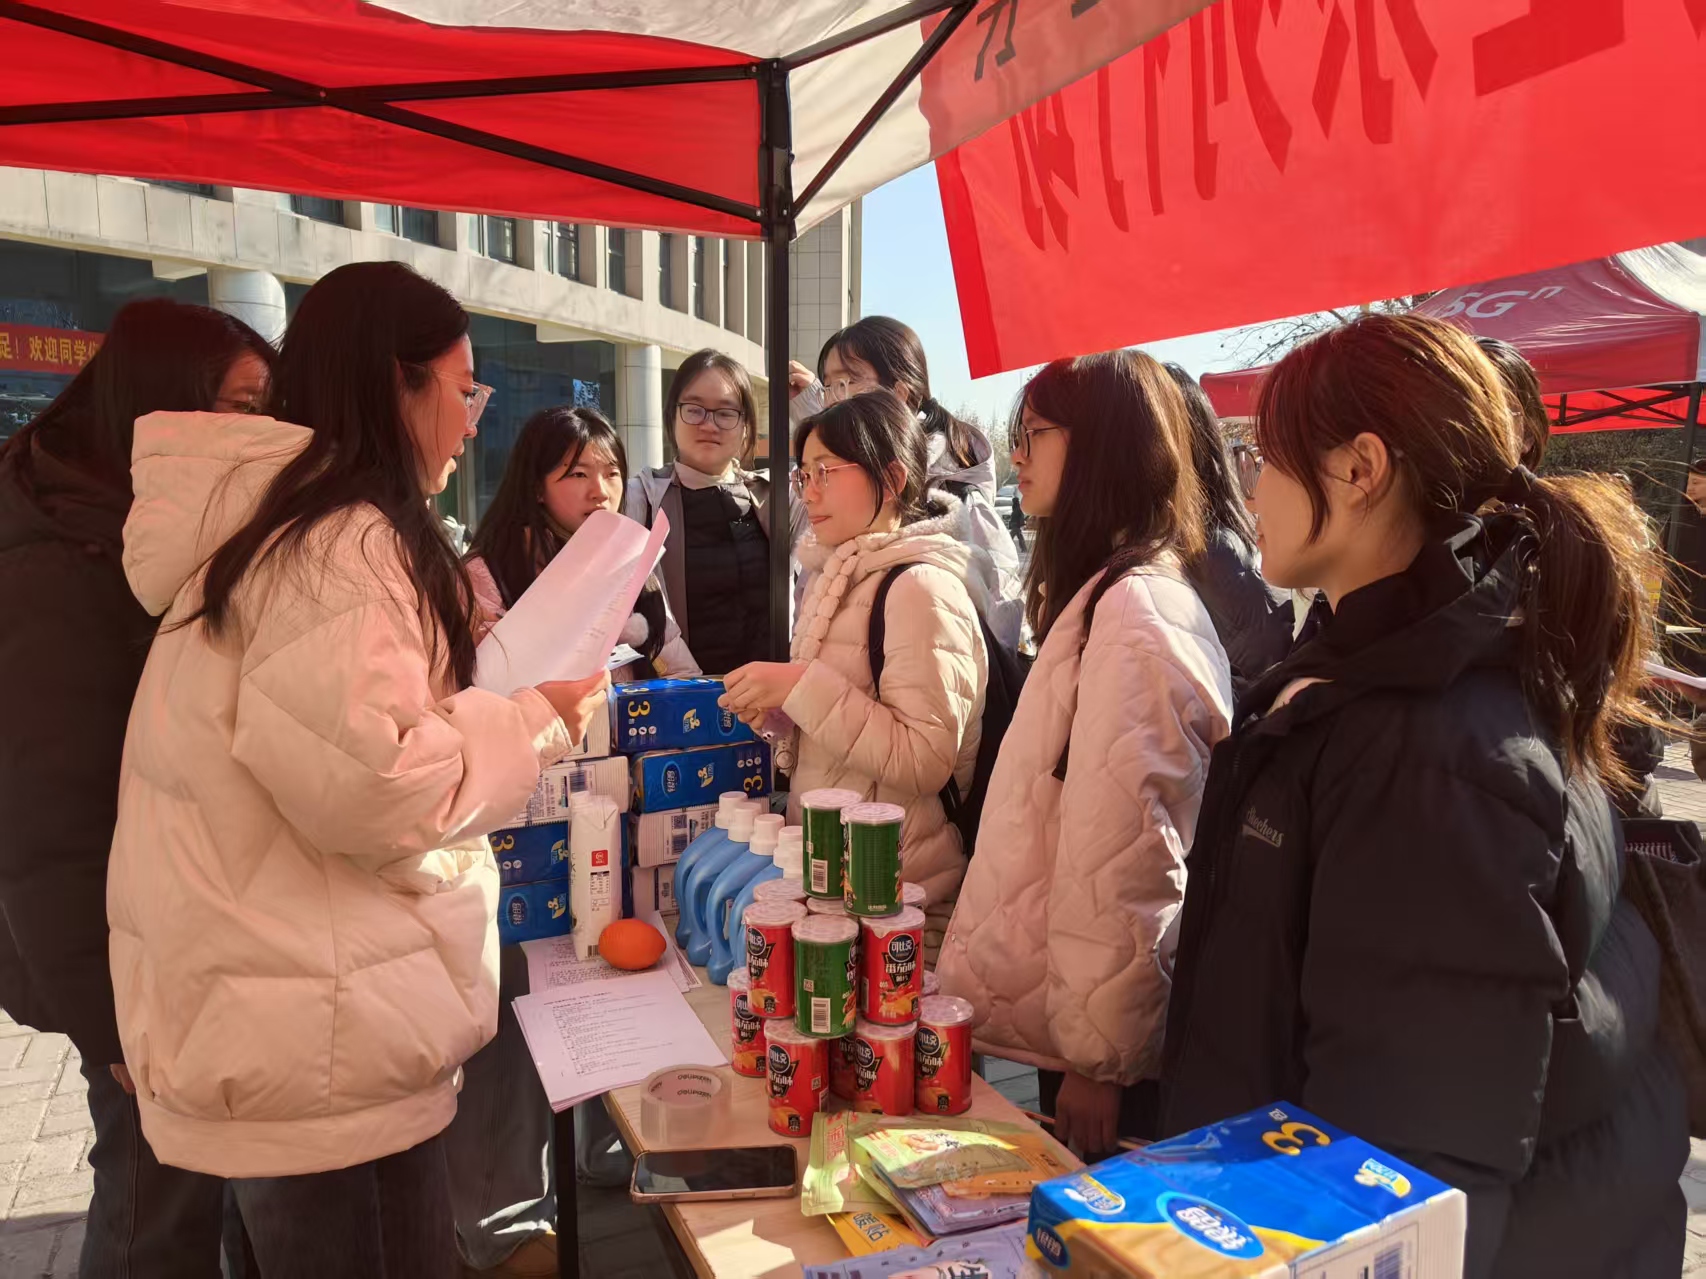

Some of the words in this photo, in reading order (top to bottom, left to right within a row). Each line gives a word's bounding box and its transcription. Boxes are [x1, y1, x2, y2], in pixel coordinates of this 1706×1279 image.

[628, 701, 650, 717] 3
[744, 775, 763, 791] 3
[891, 940, 912, 953] 可比克
[886, 961, 916, 974] 番茄味
[1262, 1122, 1331, 1156] 3
